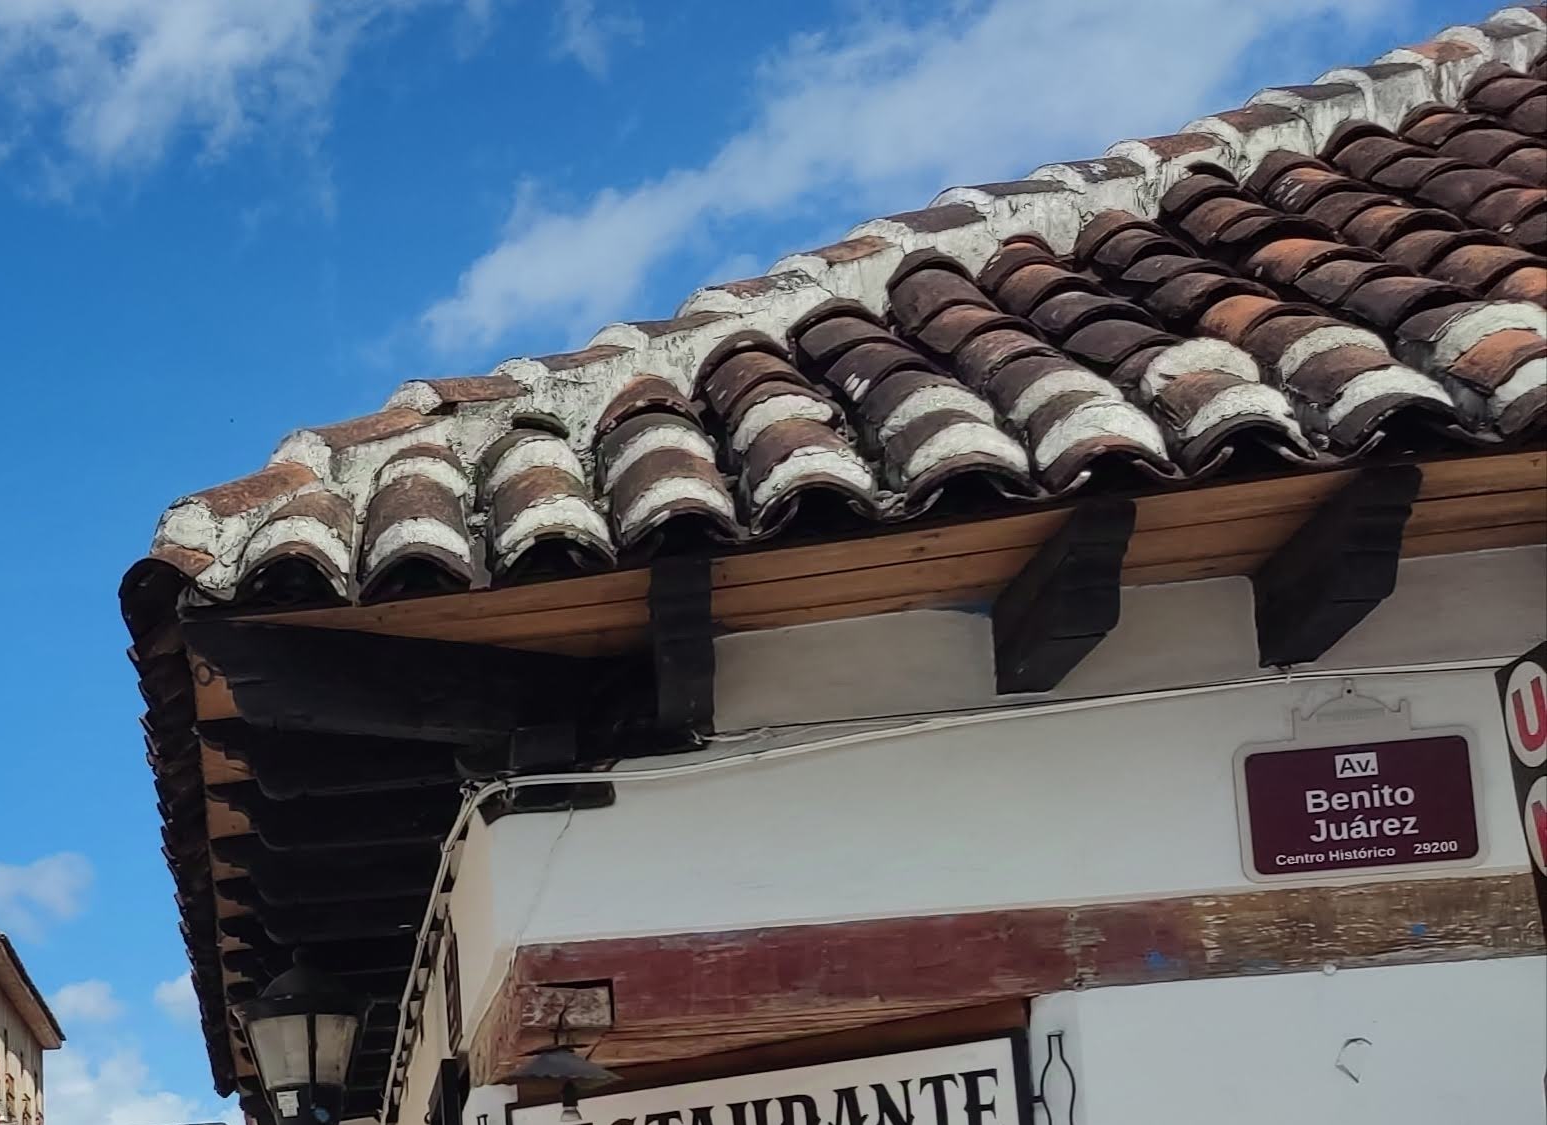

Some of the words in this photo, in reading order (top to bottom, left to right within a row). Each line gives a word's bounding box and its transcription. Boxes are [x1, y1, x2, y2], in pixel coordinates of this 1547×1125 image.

[1339, 757, 1376, 775] Av.
[1305, 784, 1415, 813] Benito
[1310, 815, 1419, 842] Juárez
[1276, 852, 1325, 866] Centro
[1329, 846, 1396, 862] Histórico
[1414, 840, 1458, 855] 29200
